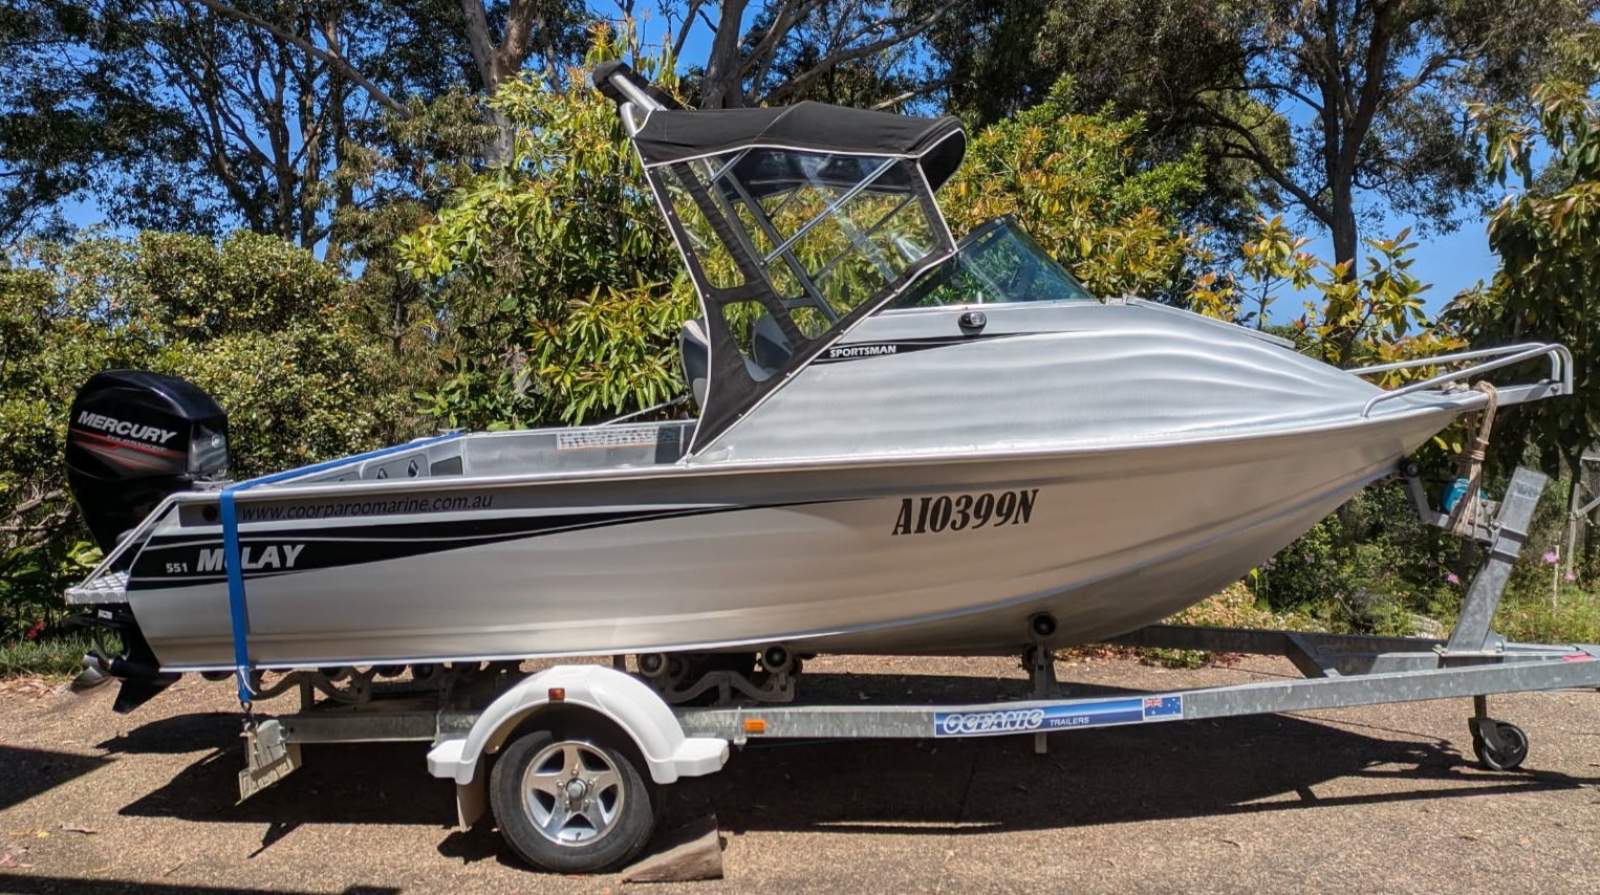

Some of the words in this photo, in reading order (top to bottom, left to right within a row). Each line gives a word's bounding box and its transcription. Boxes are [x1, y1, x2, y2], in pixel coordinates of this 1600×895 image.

[829, 345, 897, 358] SPORTSMAN
[77, 410, 177, 444] MERCURY
[241, 494, 493, 521] www.coorparoomarine.com.au
[165, 562, 189, 574] 551
[196, 544, 305, 573] MLAY
[943, 709, 1046, 734] OCEANIC
[1050, 716, 1091, 727] TRAILERS
